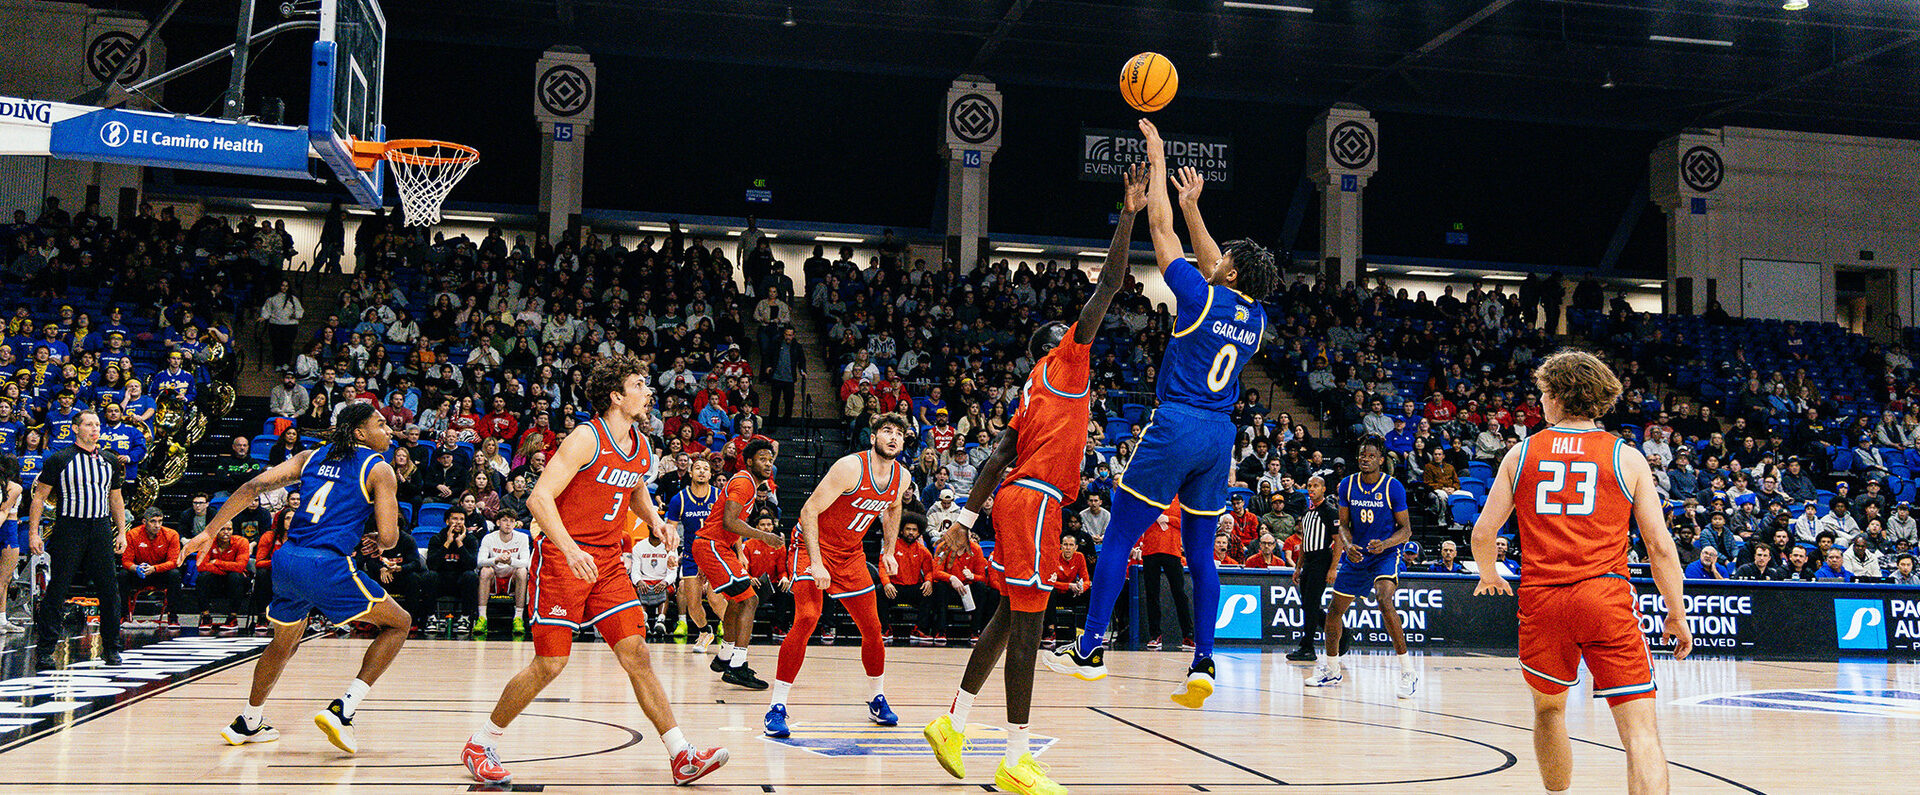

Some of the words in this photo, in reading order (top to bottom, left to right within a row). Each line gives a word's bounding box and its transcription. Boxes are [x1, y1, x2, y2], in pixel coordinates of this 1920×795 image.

[555, 126, 571, 139] 15
[132, 129, 148, 144] El
[151, 131, 209, 150] Camino
[212, 136, 264, 154] Health
[965, 153, 980, 165] 16
[1177, 157, 1227, 169] UNION
[1084, 162, 1124, 175] EVENT
[1344, 178, 1356, 190] 17
[1212, 320, 1257, 346] GARLAND
[1207, 343, 1238, 393] 0
[1551, 437, 1585, 455] HALL
[317, 464, 341, 479] BELL
[1535, 460, 1599, 516] 23
[305, 480, 335, 524] 4
[602, 491, 624, 522] 3
[851, 496, 893, 512] LOBOS
[1350, 499, 1384, 508] SPARTANS
[685, 510, 712, 518] SPARTA
[847, 511, 876, 532] 10
[1360, 508, 1375, 524] 99
[1363, 588, 1443, 608] OFICE
[1682, 594, 1752, 614] OFFICE
[548, 604, 568, 616] Lobos
[1272, 607, 1426, 630] AUMATON
[1369, 632, 1424, 642] SOLED
[1692, 637, 1736, 647] OLVED
